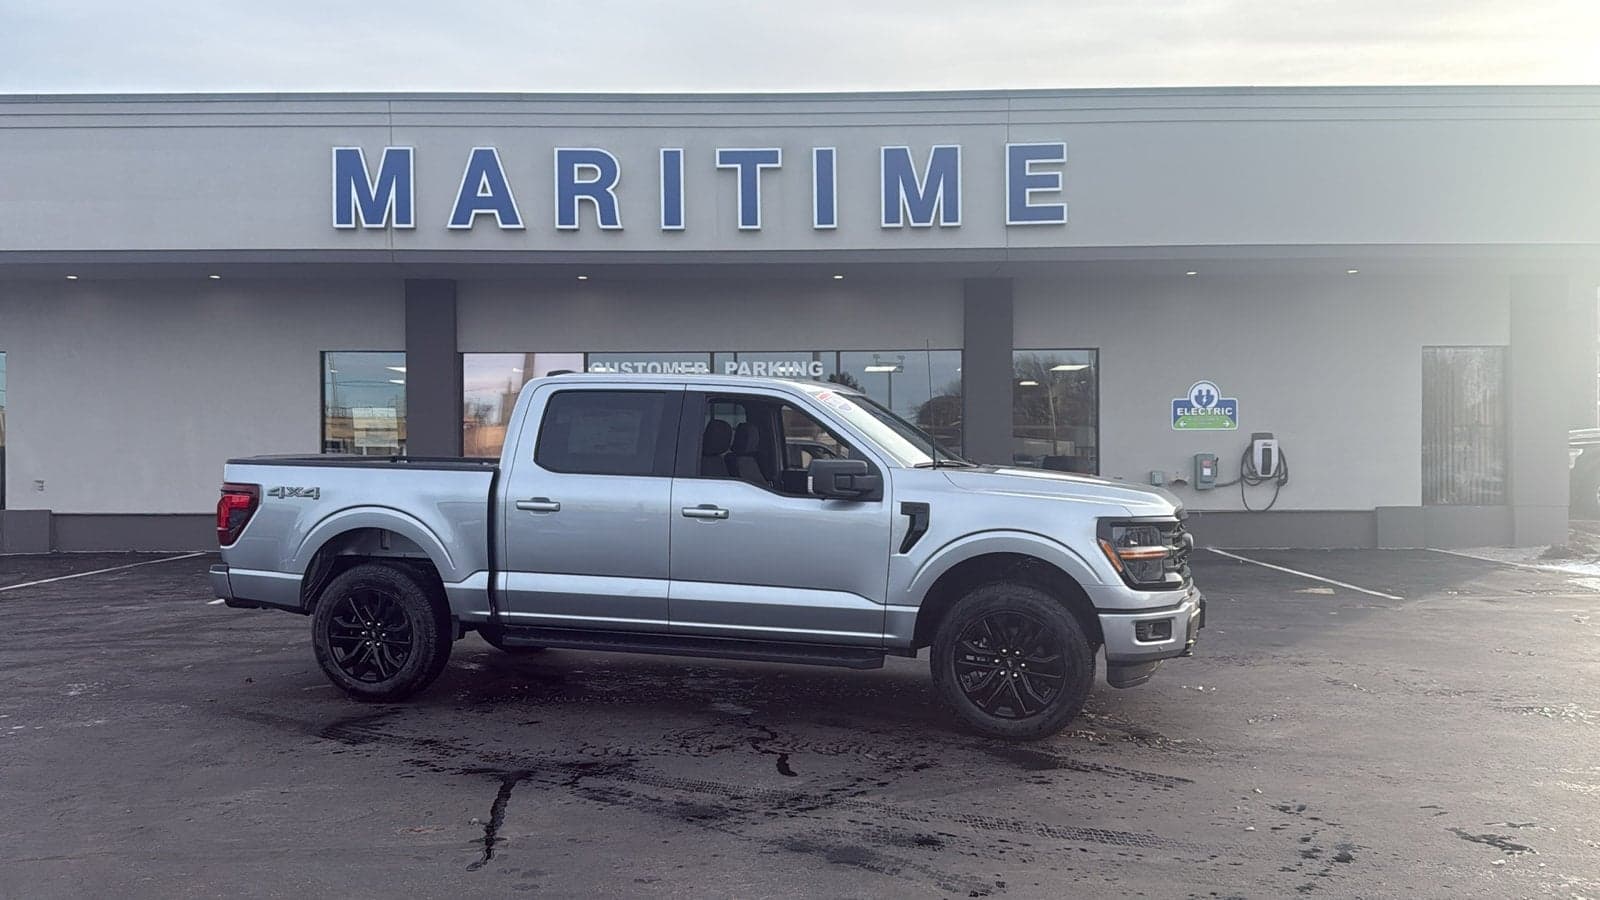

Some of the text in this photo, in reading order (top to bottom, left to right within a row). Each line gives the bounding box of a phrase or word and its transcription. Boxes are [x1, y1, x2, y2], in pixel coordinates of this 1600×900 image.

[332, 141, 1069, 231] MARITIME
[590, 361, 824, 377] CUSTOMER PARKING
[1176, 407, 1233, 416] ELECTRIC
